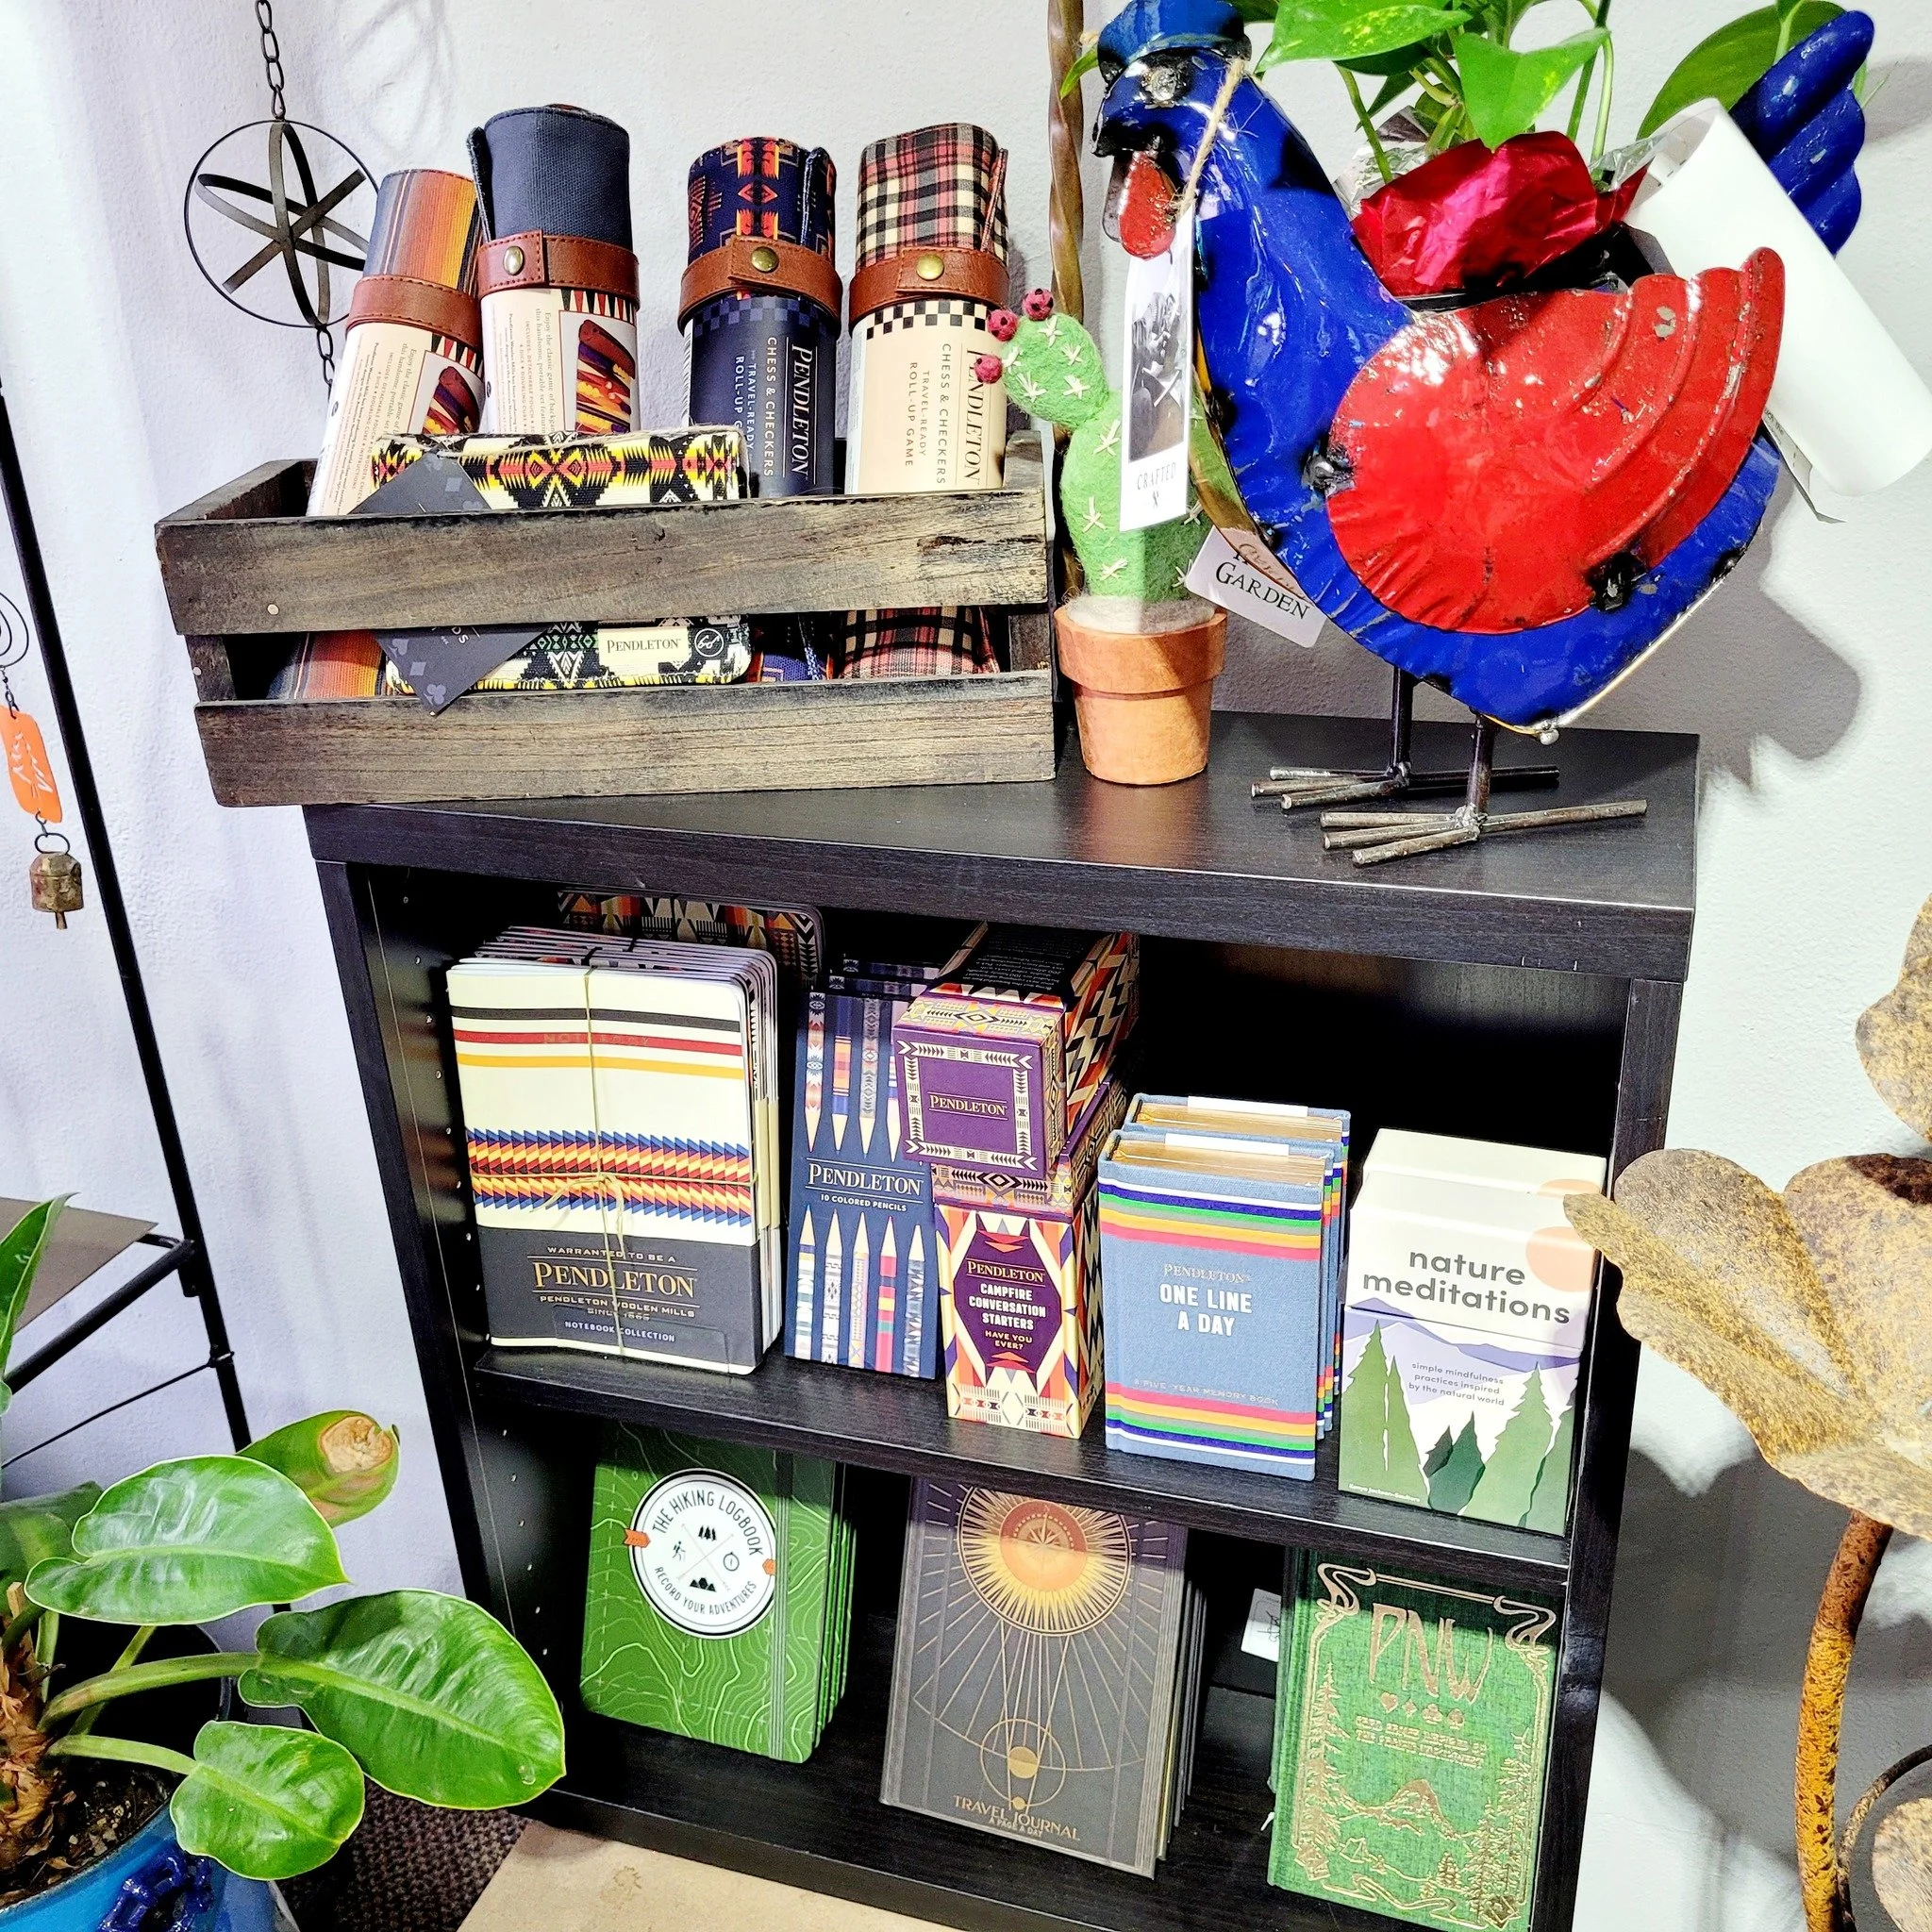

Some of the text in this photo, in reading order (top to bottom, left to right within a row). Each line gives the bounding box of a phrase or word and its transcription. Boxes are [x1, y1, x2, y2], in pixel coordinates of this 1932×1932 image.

[543, 312, 552, 331] Enjoy
[406, 348, 417, 367] Enjoy
[767, 337, 777, 382] CHESS
[941, 343, 951, 389] CHESS
[399, 380, 410, 401] classic
[734, 356, 744, 413] ROLL-UP
[394, 402, 404, 420] game
[747, 363, 757, 449] TRAVEL-READY
[791, 344, 812, 475] PENDLETON
[906, 362, 917, 466] ROLL-UP GAME
[920, 371, 929, 456] TRAVEL-READY
[764, 401, 775, 476] CHECKERS
[937, 409, 948, 484] CHECKERS
[1138, 462, 1175, 490] CRAFTED
[1216, 562, 1309, 619] GARDEN
[608, 640, 678, 653] PENDLETON
[930, 1095, 1006, 1115] PENDLETON
[808, 1163, 923, 1195] PENDLETON
[832, 1195, 871, 1207] COLORED
[873, 1201, 907, 1211] PENCILS
[967, 1261, 1043, 1282] PENDLETON
[1164, 1264, 1244, 1283] PENDLETON
[1409, 1251, 1525, 1285] nature
[532, 1262, 694, 1299] PENDLETON
[980, 1283, 1032, 1301] CAMPFIRE
[540, 1295, 608, 1307] PENDLETON
[661, 1307, 695, 1318] MILLS
[969, 1296, 1046, 1317] CONVERSATION
[1159, 1283, 1253, 1313] ONE LINE
[1363, 1274, 1570, 1324] meditations
[565, 1322, 675, 1341] NOTEBOOK COLLECTION
[982, 1313, 1034, 1330] STARTERS
[1177, 1311, 1236, 1336] A DAY
[985, 1330, 1032, 1343] HAVE YOU
[995, 1341, 1024, 1349] EVER?
[1412, 1363, 1504, 1384] simple mindfulness
[1415, 1374, 1500, 1393] practices inspired
[1203, 1389, 1246, 1399] MEMORY
[1249, 1395, 1278, 1406] BOOK
[1408, 1383, 1420, 1391] by
[1441, 1389, 1474, 1400] natural
[1477, 1396, 1505, 1406] world
[652, 1490, 764, 1556] THE HIKING LOGBOOK
[655, 1566, 757, 1616] RECORD YOUR ADVENTURES
[1368, 1602, 1494, 1705] PNW
[953, 1795, 1080, 1841] TRAVEL JOURNAL
[997, 1819, 1018, 1830] PAGE
[1027, 1828, 1043, 1838] DAY
